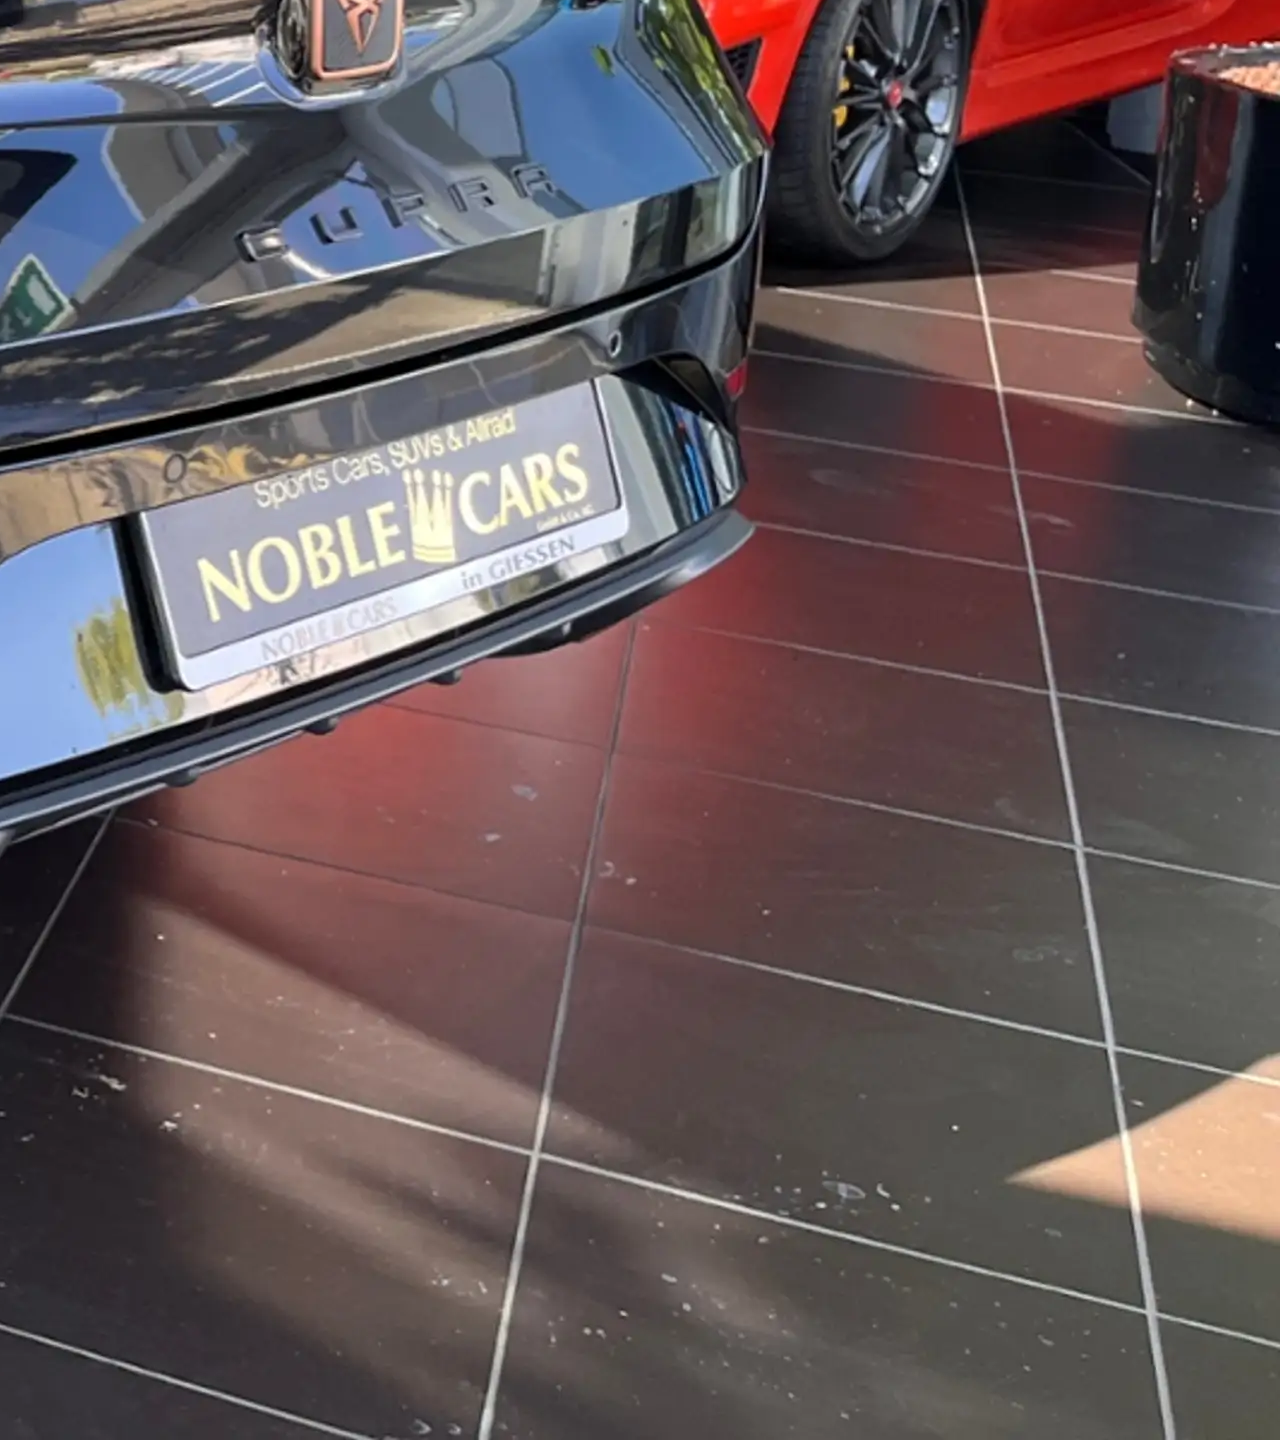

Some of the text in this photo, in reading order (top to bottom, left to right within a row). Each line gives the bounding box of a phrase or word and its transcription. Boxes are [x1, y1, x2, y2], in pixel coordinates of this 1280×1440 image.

[237, 161, 559, 261] CUPRA
[253, 468, 330, 510] Sports
[331, 451, 391, 486] Cars,
[388, 433, 445, 471] SUVs
[445, 428, 464, 453] &
[196, 443, 589, 623] NOBLE CARS
[460, 533, 577, 591] in GIESSEN
